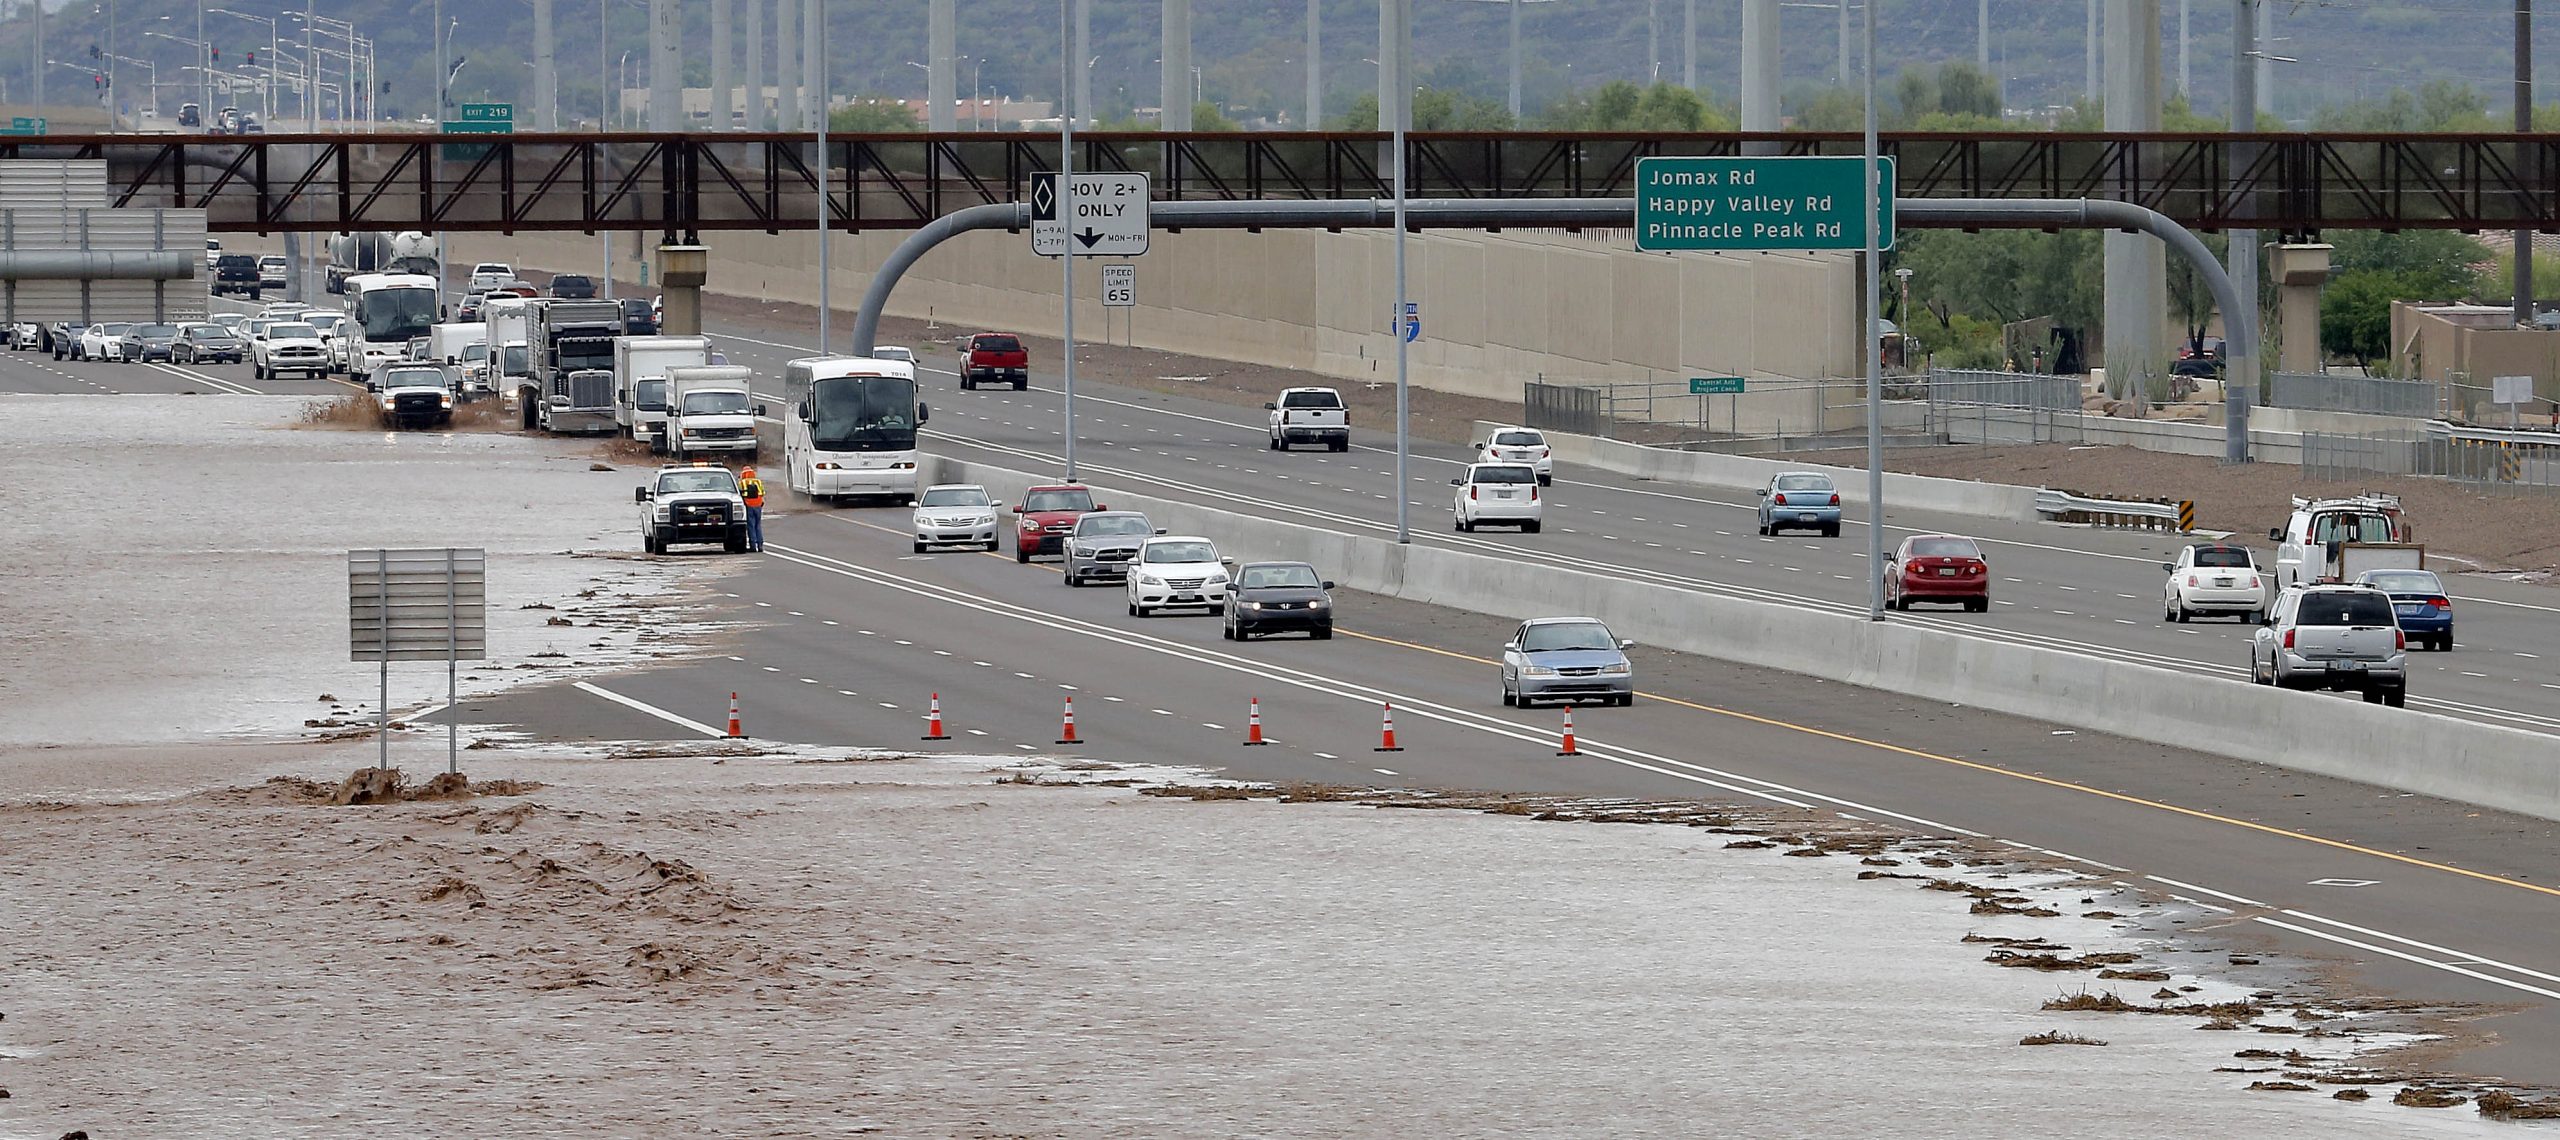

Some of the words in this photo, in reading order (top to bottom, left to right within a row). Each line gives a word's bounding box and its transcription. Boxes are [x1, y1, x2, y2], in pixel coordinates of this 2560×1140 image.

[489, 108, 508, 116] 219
[1650, 170, 1718, 185] Jomax
[1730, 169, 1755, 185] Rd
[1071, 183, 1103, 196] HOV
[1114, 183, 1137, 196] 2+
[1078, 203, 1126, 217] ONLY
[1649, 196, 1715, 216] Happy
[1728, 195, 1794, 215] Valley
[1806, 195, 1831, 211] Rd
[1056, 226, 1065, 234] A
[1649, 222, 1742, 238] Pinnacle
[1754, 222, 1804, 238] Peak
[1816, 222, 1841, 238] Rd
[1056, 238, 1065, 246] P
[1108, 234, 1145, 242] MON-FRI
[1108, 289, 1130, 301] 65
